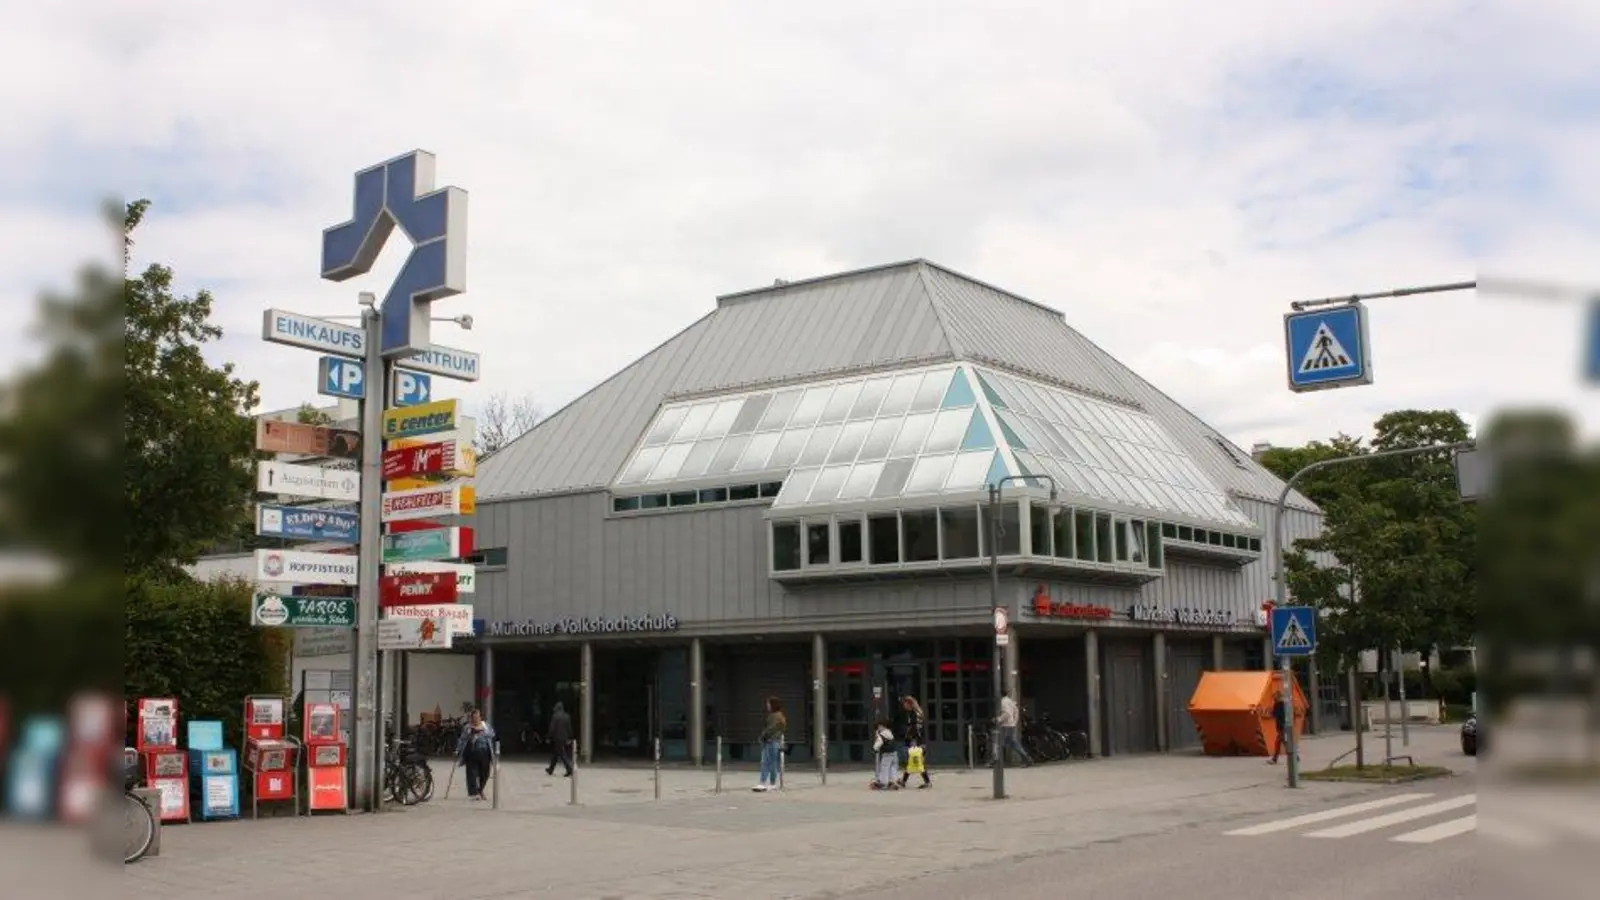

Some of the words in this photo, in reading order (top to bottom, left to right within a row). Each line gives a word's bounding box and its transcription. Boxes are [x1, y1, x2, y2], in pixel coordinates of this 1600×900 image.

[276, 317, 362, 350] EINKAUFS
[410, 349, 476, 374] ENTRUM
[342, 363, 362, 392] P
[398, 374, 416, 402] P
[400, 411, 452, 431] center
[289, 561, 355, 575] HOFPFISTEREI
[297, 599, 348, 615] FAROS
[490, 619, 557, 637] Münchner
[559, 611, 678, 634] Volkshochschule
